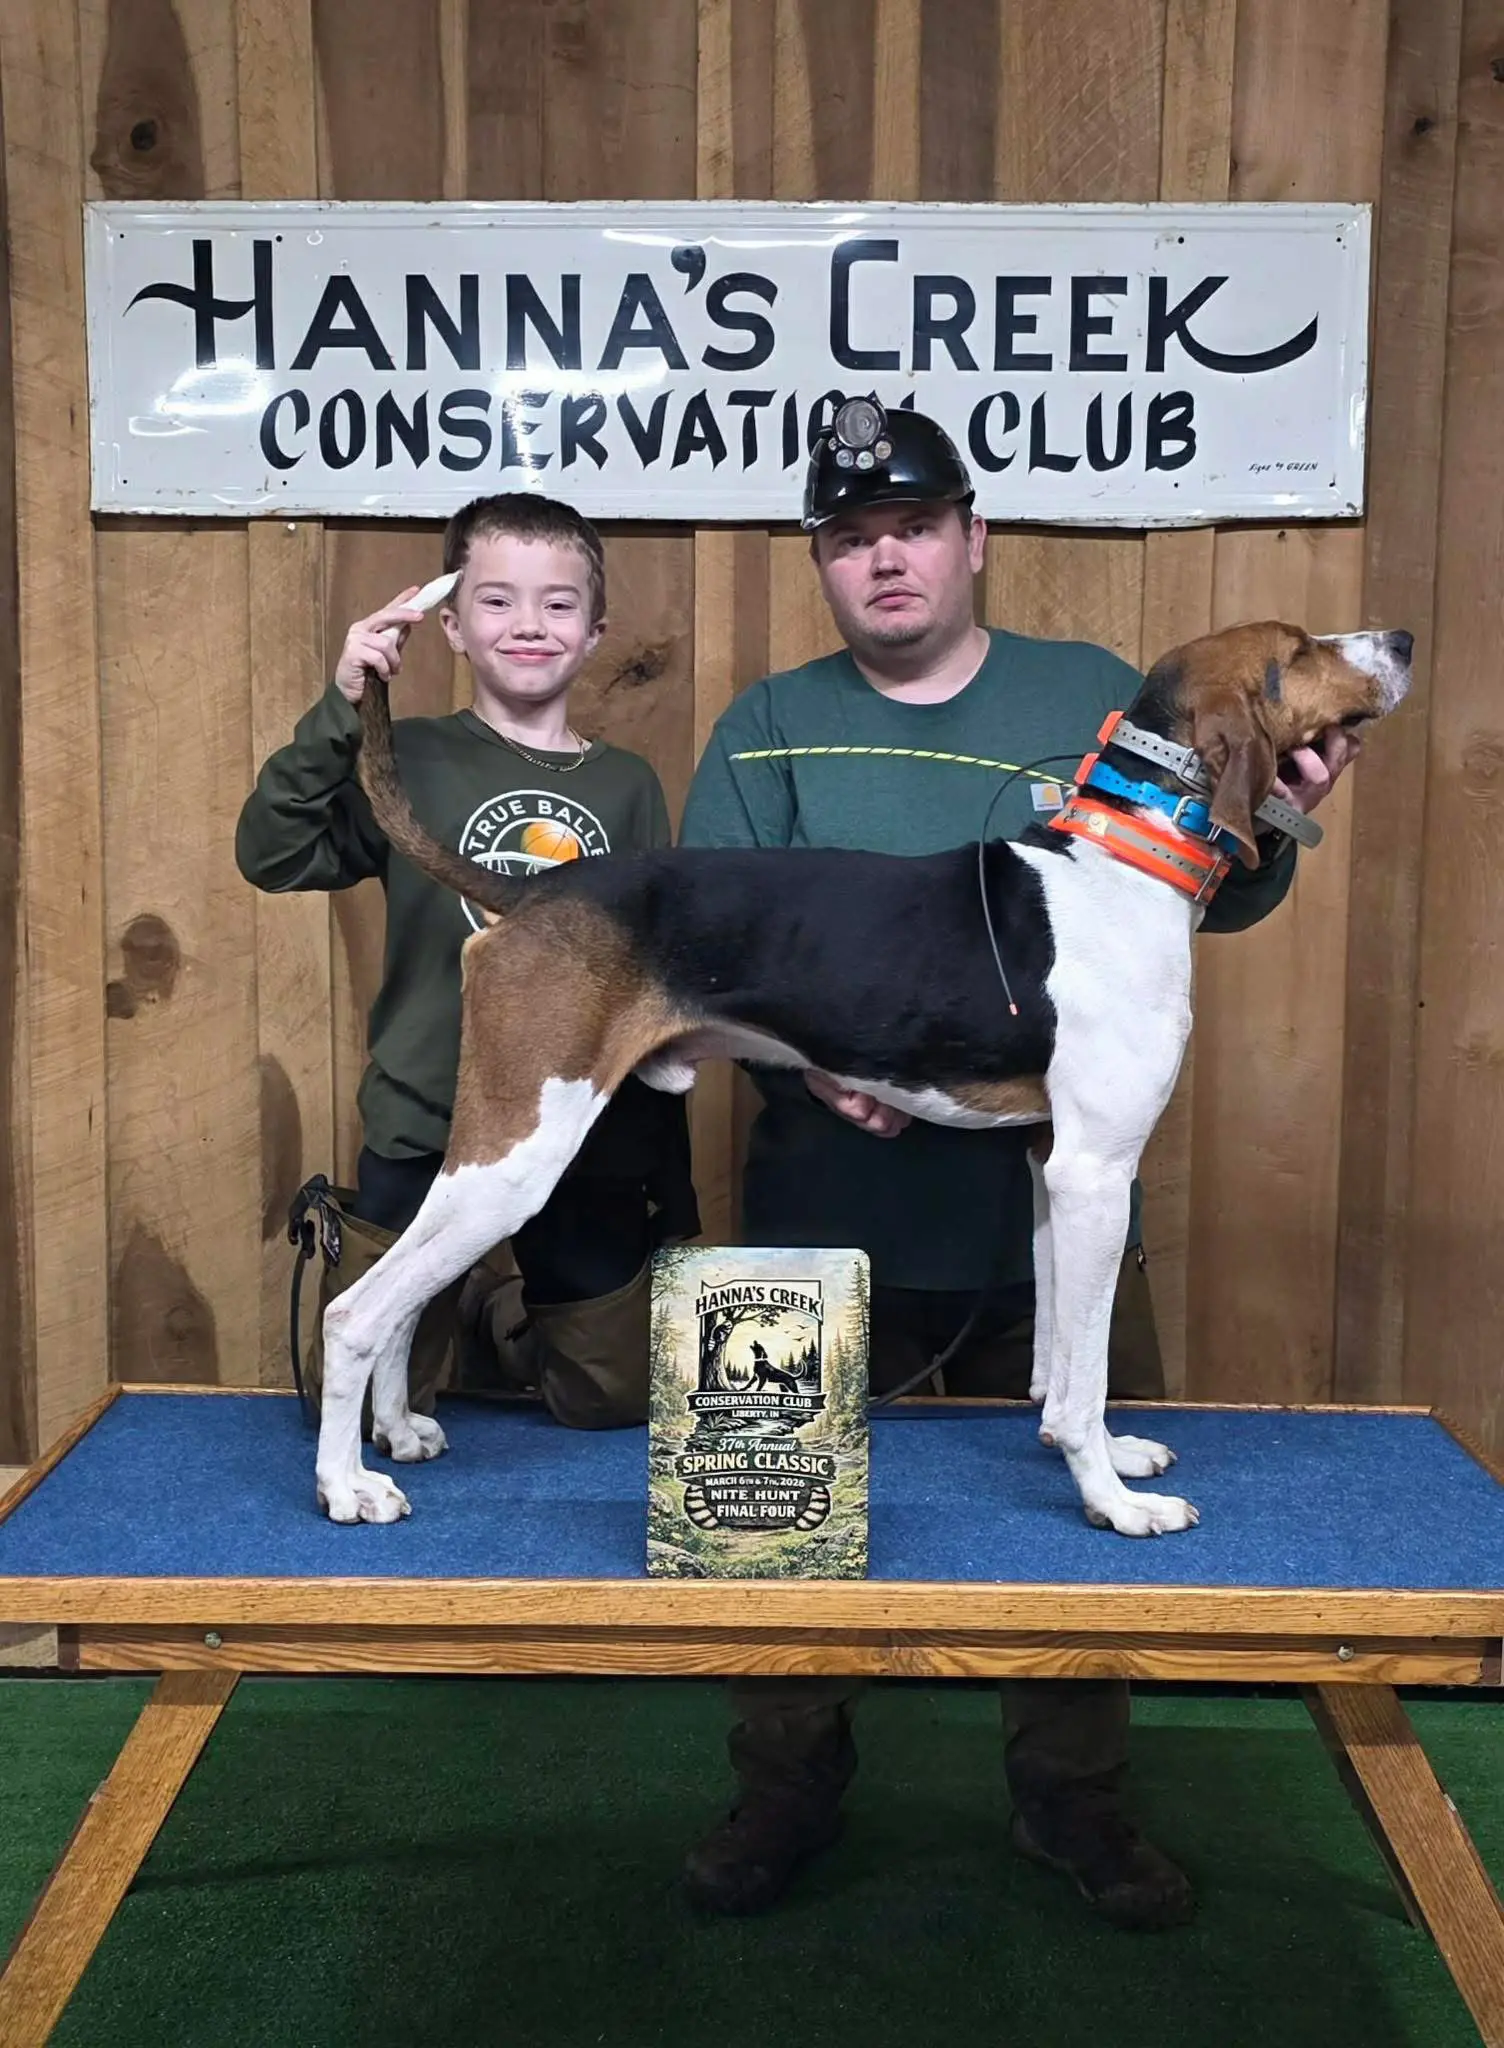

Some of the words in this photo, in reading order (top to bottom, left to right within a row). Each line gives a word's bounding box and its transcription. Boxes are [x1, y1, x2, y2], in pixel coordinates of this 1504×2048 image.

[123, 239, 778, 372] HANNA'S
[830, 238, 1318, 374] CREEK
[967, 389, 1197, 474] CLUB
[468, 800, 527, 851] TRUE
[695, 1286, 765, 1315] HANNA'S
[769, 1288, 820, 1316] CREEK
[695, 1395, 779, 1407] CONSERVATION
[782, 1396, 812, 1408] CLUB
[769, 1410, 780, 1418] IN
[717, 1437, 745, 1452] 37th
[747, 1437, 797, 1451] Annual
[682, 1452, 748, 1474] SPRING
[753, 1452, 829, 1475] CLASSIC
[705, 1477, 737, 1486] MARCH
[780, 1477, 806, 1488] 2026
[711, 1489, 749, 1501] NITE
[754, 1490, 801, 1501] HUNT
[717, 1504, 757, 1518] FINAL
[760, 1505, 796, 1518] FOUR
